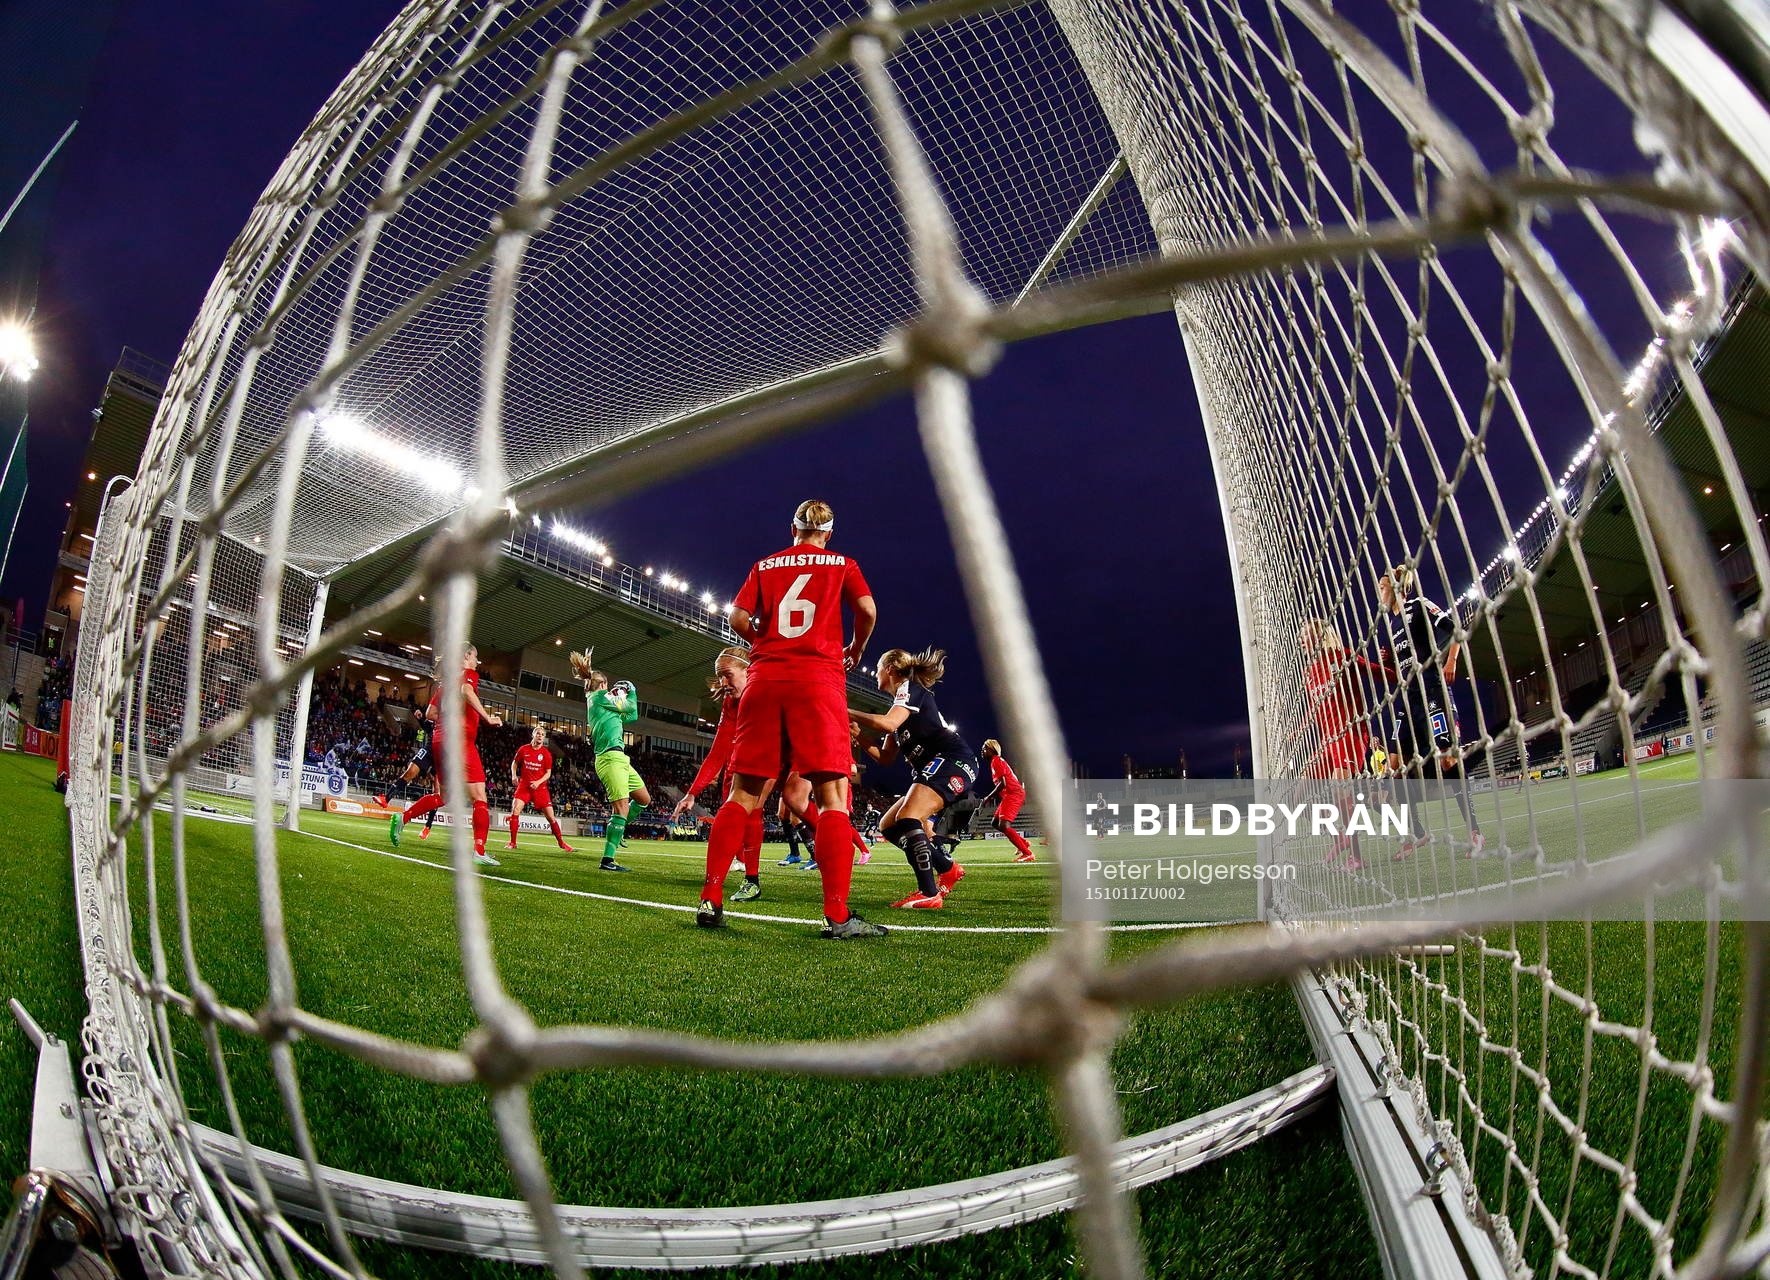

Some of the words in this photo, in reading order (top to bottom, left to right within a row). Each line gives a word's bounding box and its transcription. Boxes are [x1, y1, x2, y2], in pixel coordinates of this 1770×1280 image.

[758, 554, 846, 572] ESKILSTUNA
[778, 573, 817, 639] 6
[281, 771, 325, 784] ESSTUNA
